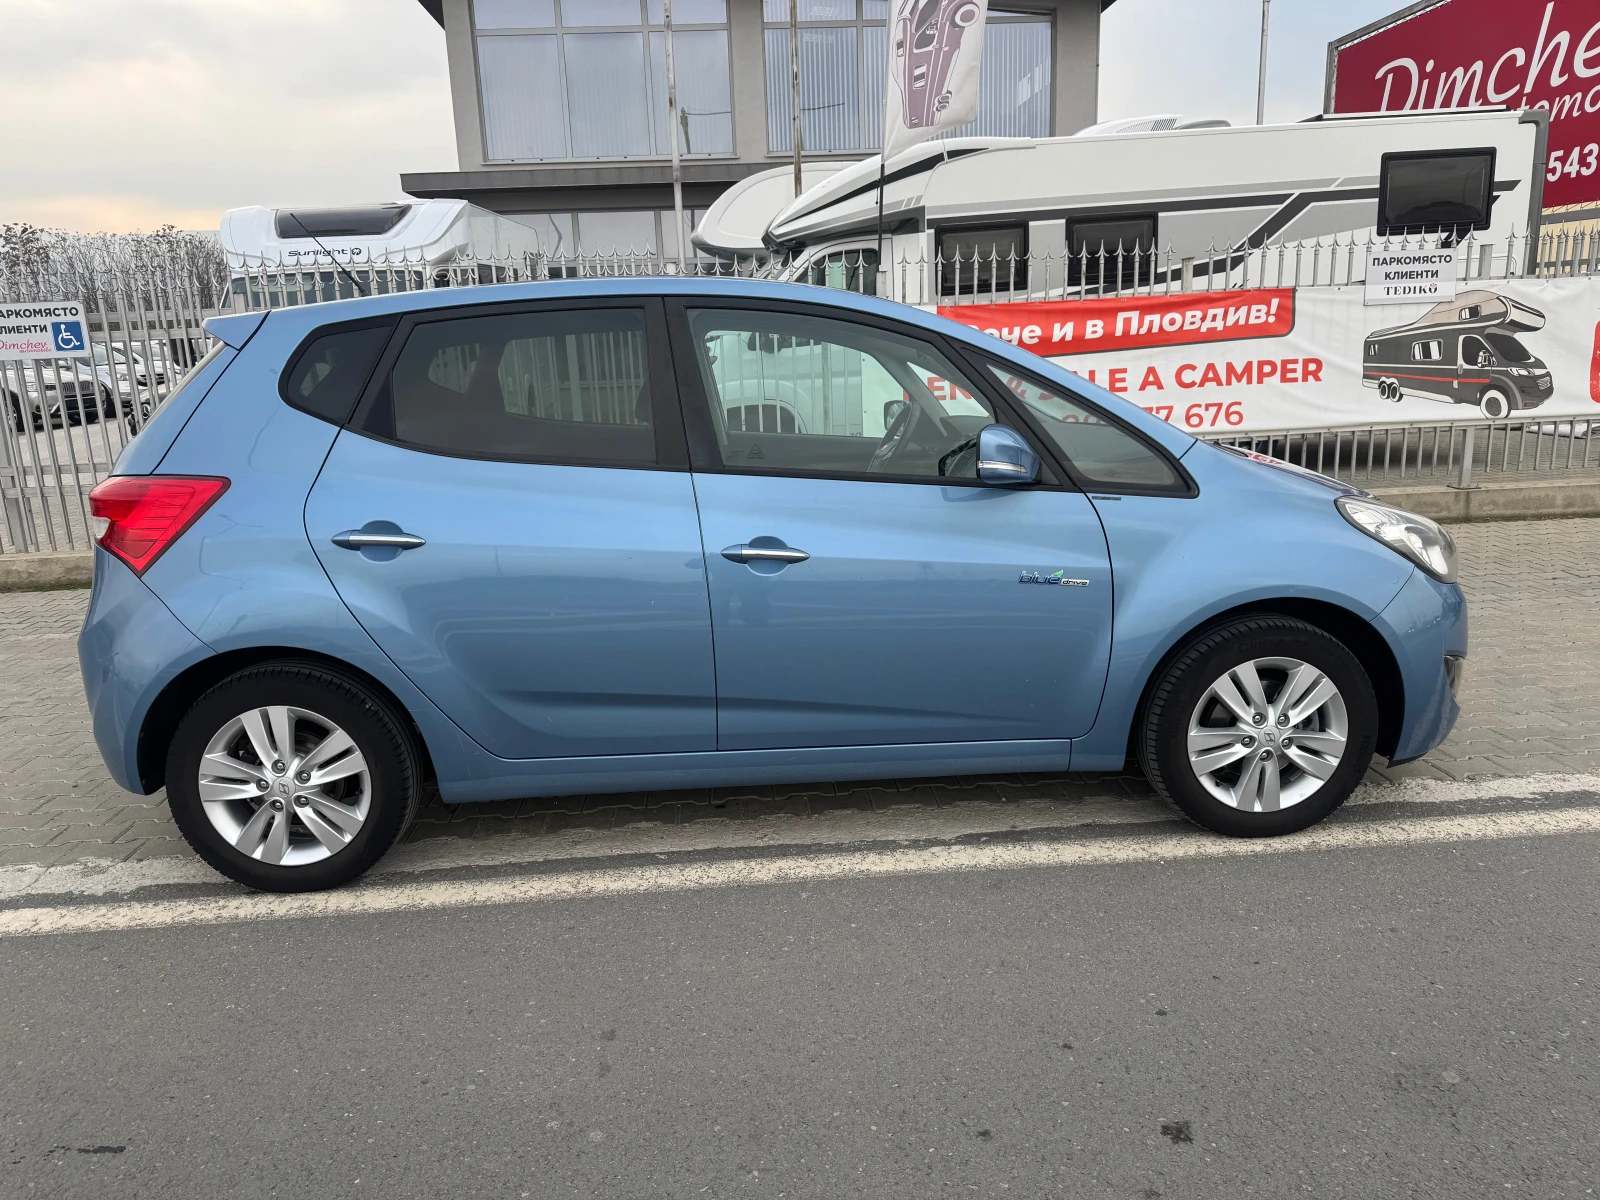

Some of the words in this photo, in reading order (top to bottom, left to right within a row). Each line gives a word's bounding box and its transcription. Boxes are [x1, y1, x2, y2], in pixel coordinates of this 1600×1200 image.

[1547, 142, 1599, 182] 543
[287, 248, 348, 257] Sunlight
[1372, 254, 1453, 267] ПАРКОМЯСТО
[1384, 269, 1439, 281] КЛИЕНТИ
[1051, 321, 1074, 343] и
[1084, 319, 1104, 340] в
[1114, 298, 1279, 336] Пловдив!
[1138, 366, 1165, 391] A
[1174, 357, 1323, 389] CAMPER
[1185, 401, 1244, 428] 676
[1018, 570, 1061, 585] blue
